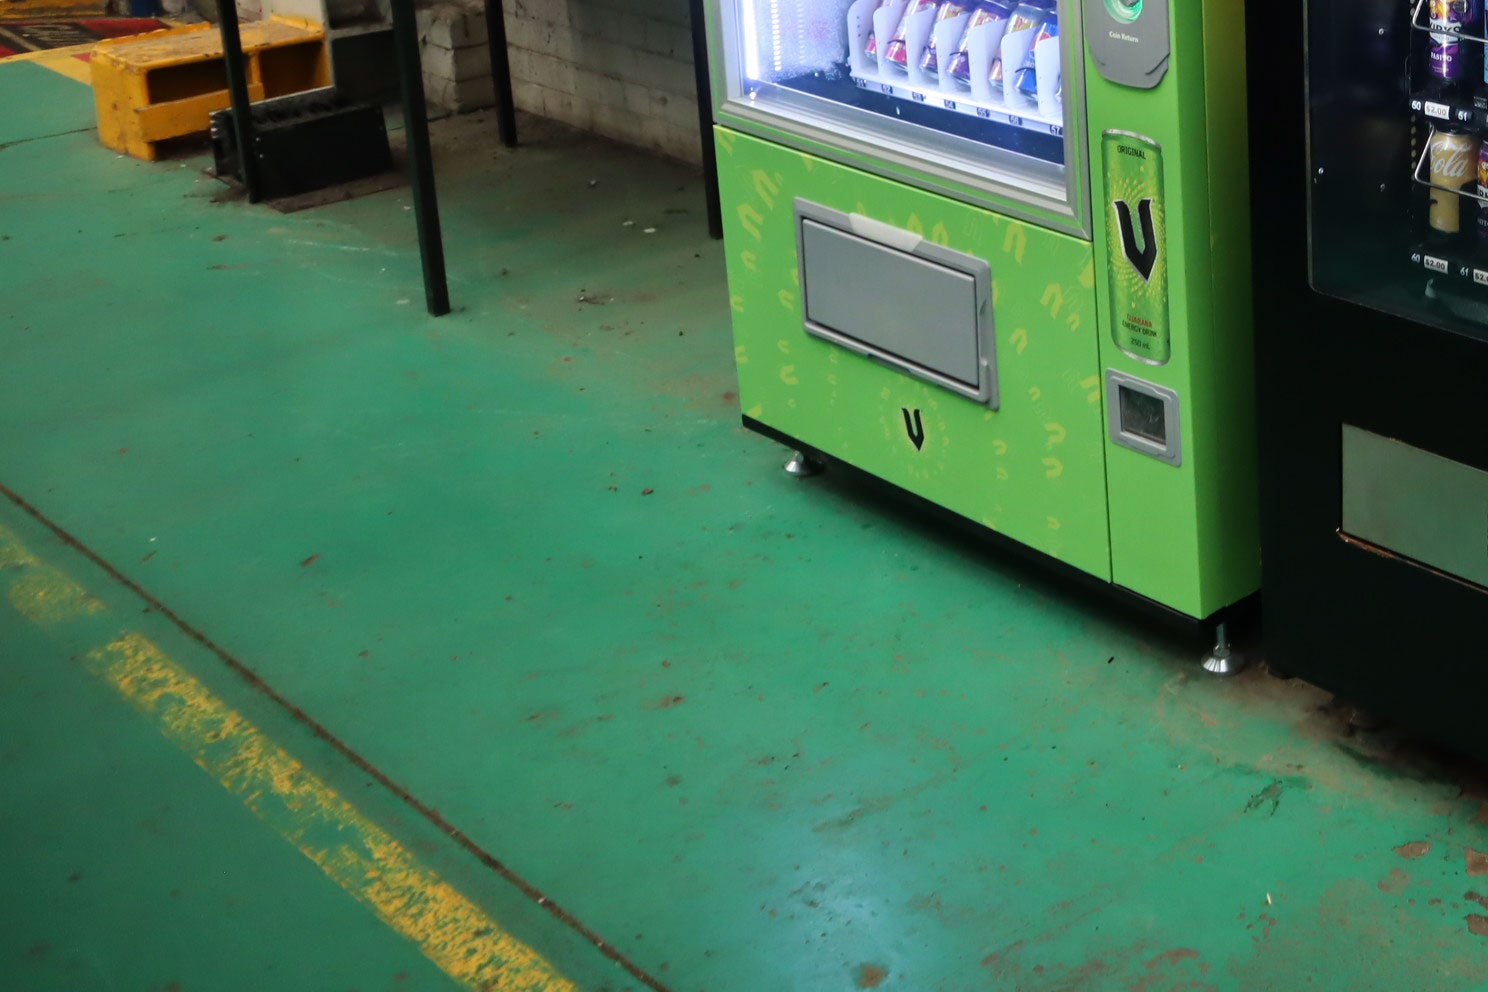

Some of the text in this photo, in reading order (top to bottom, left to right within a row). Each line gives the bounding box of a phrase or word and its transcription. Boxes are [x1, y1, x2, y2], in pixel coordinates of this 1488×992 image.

[1109, 30, 1121, 40] Coin
[1412, 101, 1421, 111] 50
[1426, 105, 1447, 116] $2.00
[1458, 111, 1468, 121] 51
[1050, 125, 1061, 135] 57
[1117, 144, 1146, 160] ORIGINAL
[1113, 198, 1158, 284] V
[1411, 254, 1421, 263] 60
[1425, 259, 1445, 270] $2.00
[1460, 266, 1469, 276] 61
[901, 407, 925, 453] V
